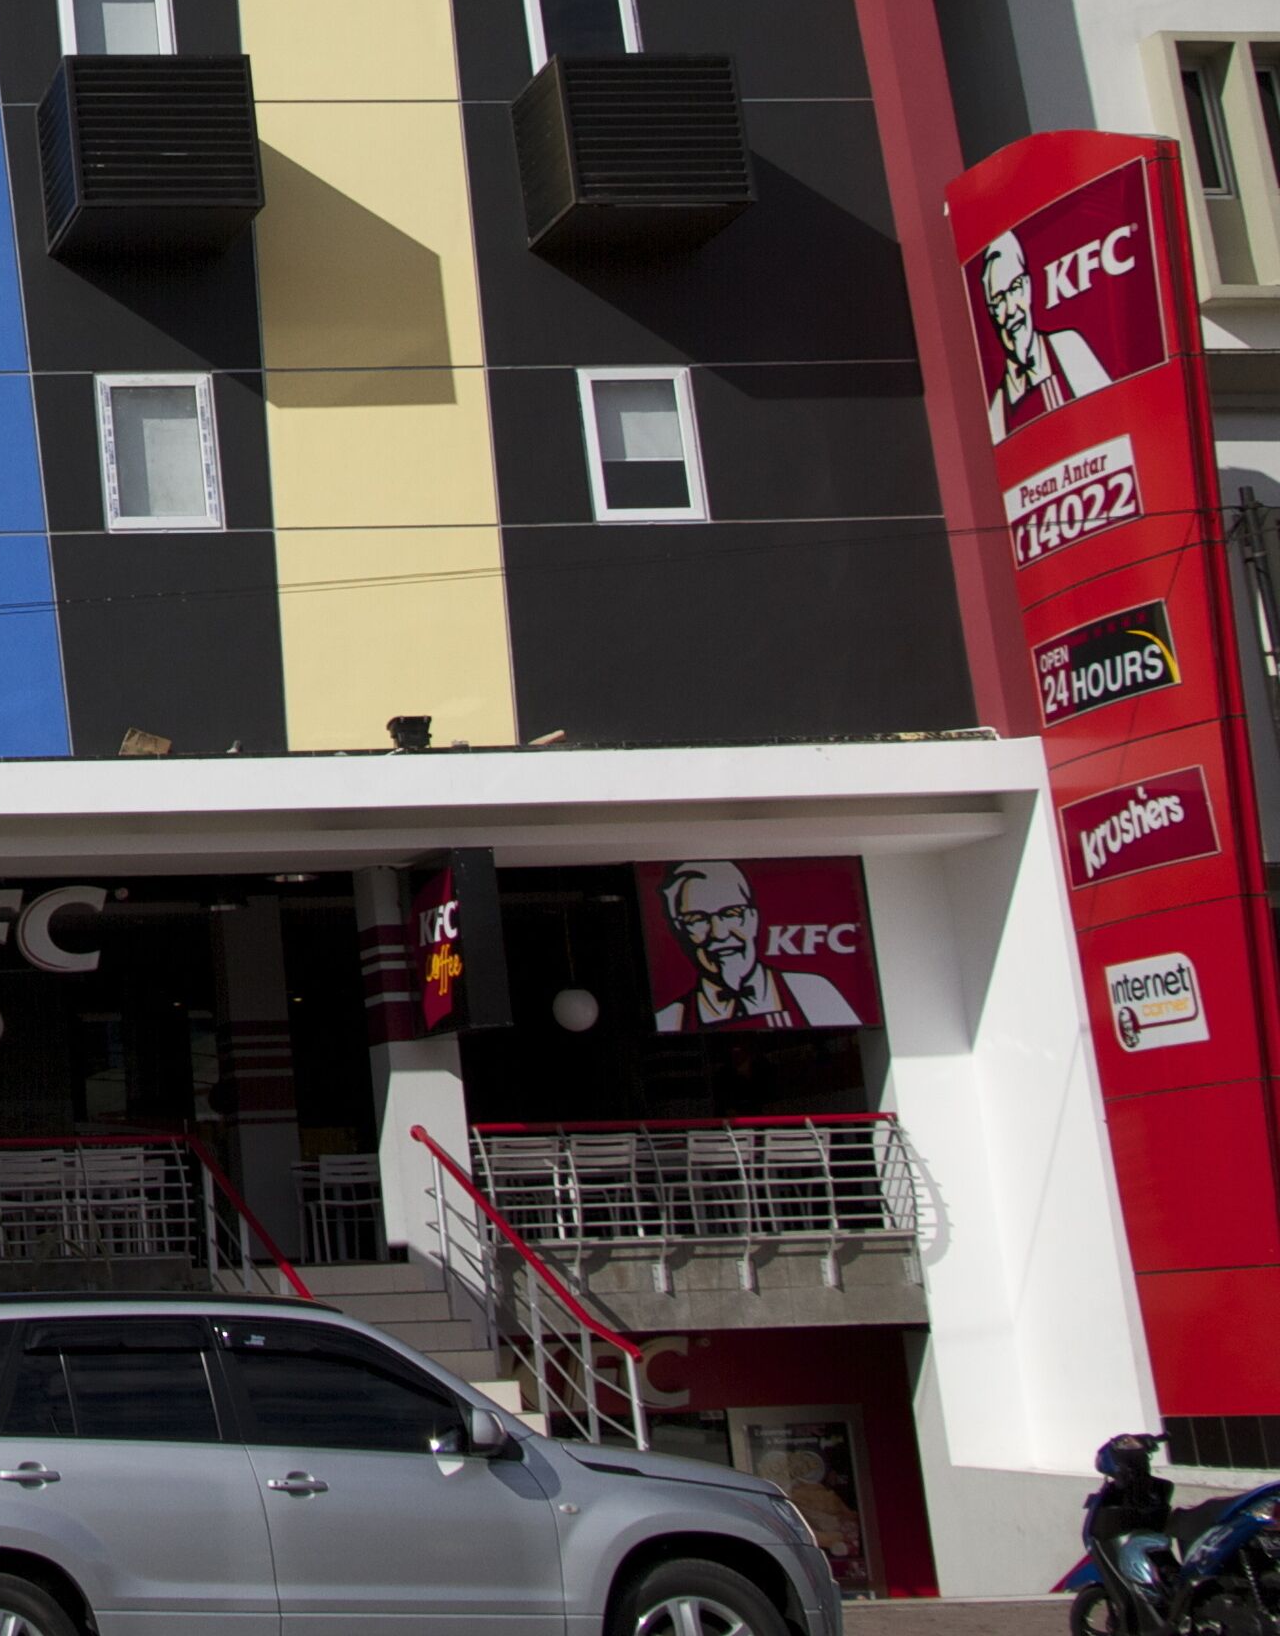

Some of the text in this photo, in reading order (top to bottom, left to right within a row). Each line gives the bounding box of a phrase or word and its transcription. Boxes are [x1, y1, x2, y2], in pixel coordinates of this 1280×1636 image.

[1044, 225, 1135, 309] KFC
[1019, 454, 1107, 509] Pesan Antar
[1027, 472, 1136, 558] 14022
[1040, 645, 1069, 673] OPEN
[1044, 643, 1164, 714] 24 HOURS
[1081, 787, 1184, 878] krushers
[420, 901, 458, 947] KFC
[764, 924, 856, 956] KFC
[1111, 963, 1189, 1004] internet
